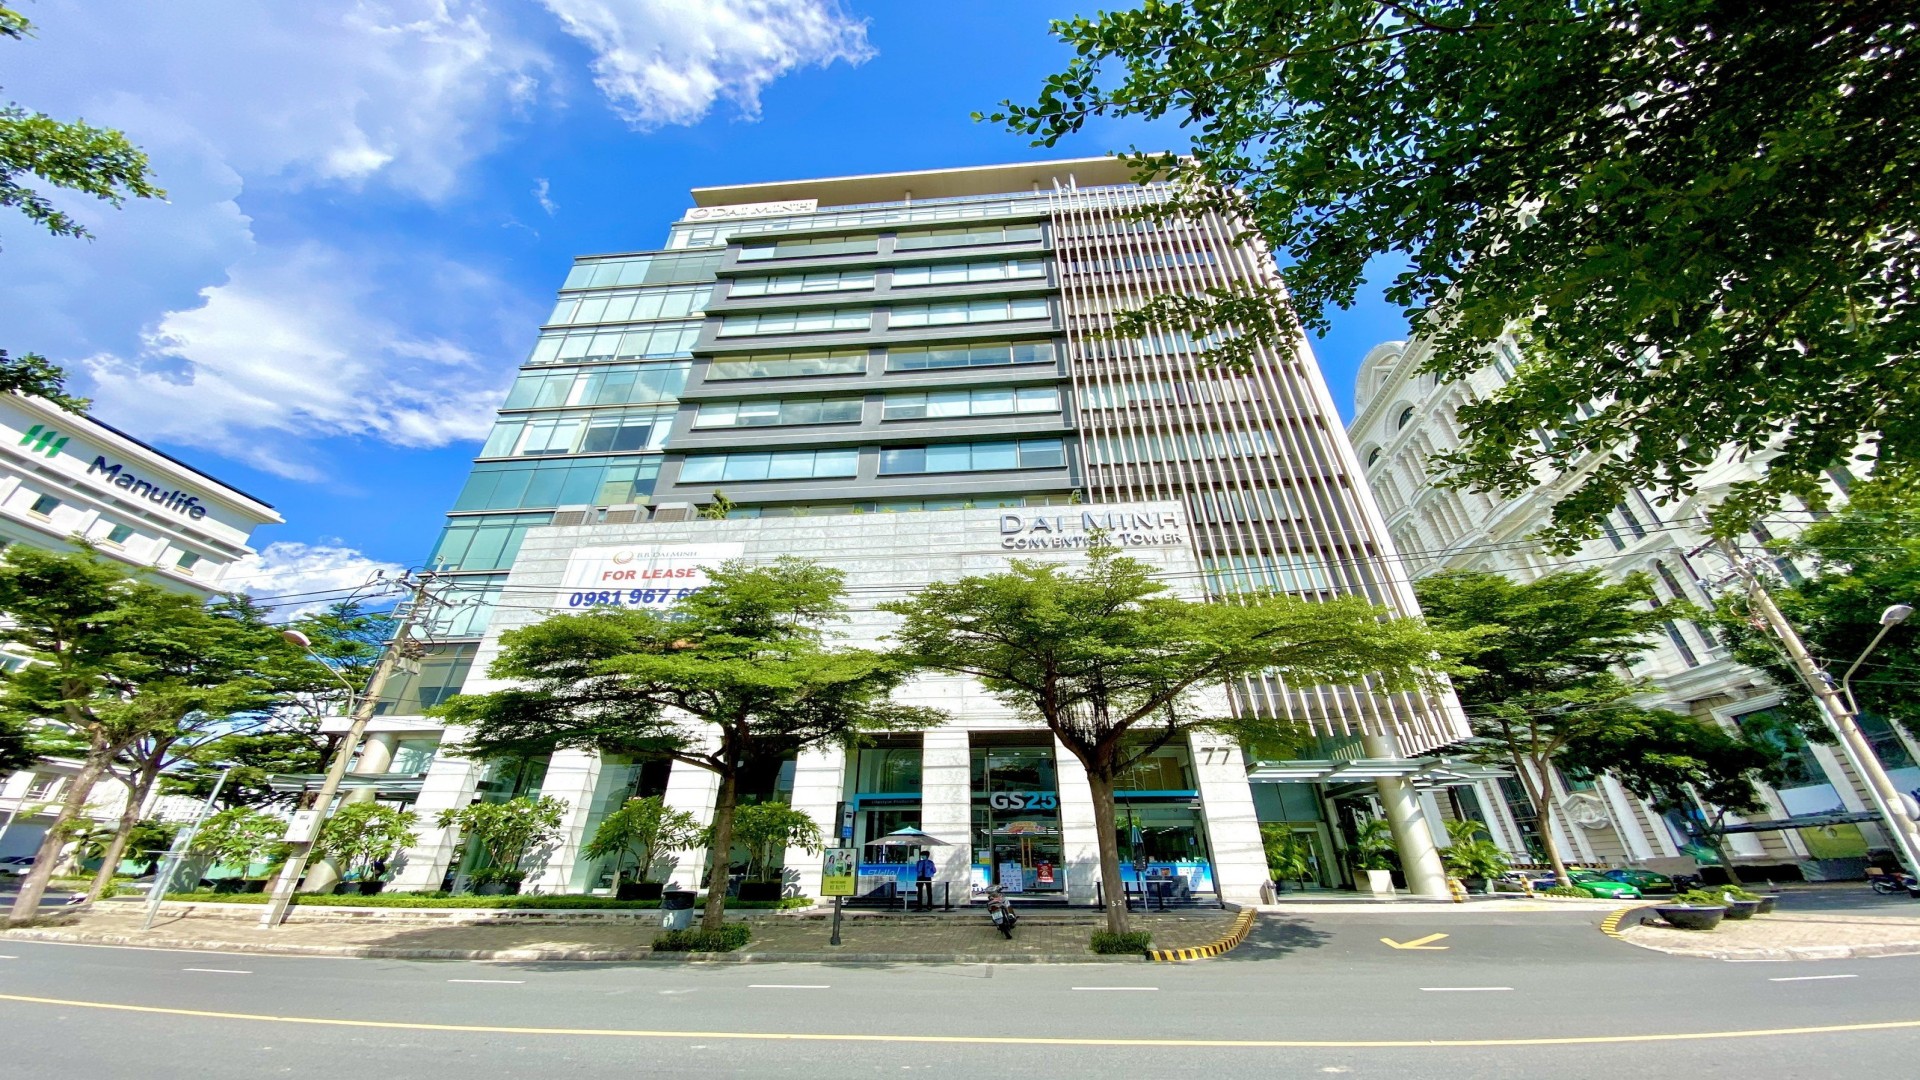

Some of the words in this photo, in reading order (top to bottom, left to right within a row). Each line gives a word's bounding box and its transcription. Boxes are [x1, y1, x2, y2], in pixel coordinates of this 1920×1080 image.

[86, 455, 207, 521] Manulife
[1000, 513, 1065, 535] DAI
[1081, 510, 1180, 532] MINH
[1118, 532, 1183, 546] TOWER
[602, 570, 636, 581] FOR
[642, 568, 698, 580] LEASE
[569, 591, 621, 607] 0981
[628, 588, 671, 605] 967
[1201, 747, 1232, 765] 77
[990, 791, 1058, 810] GS25
